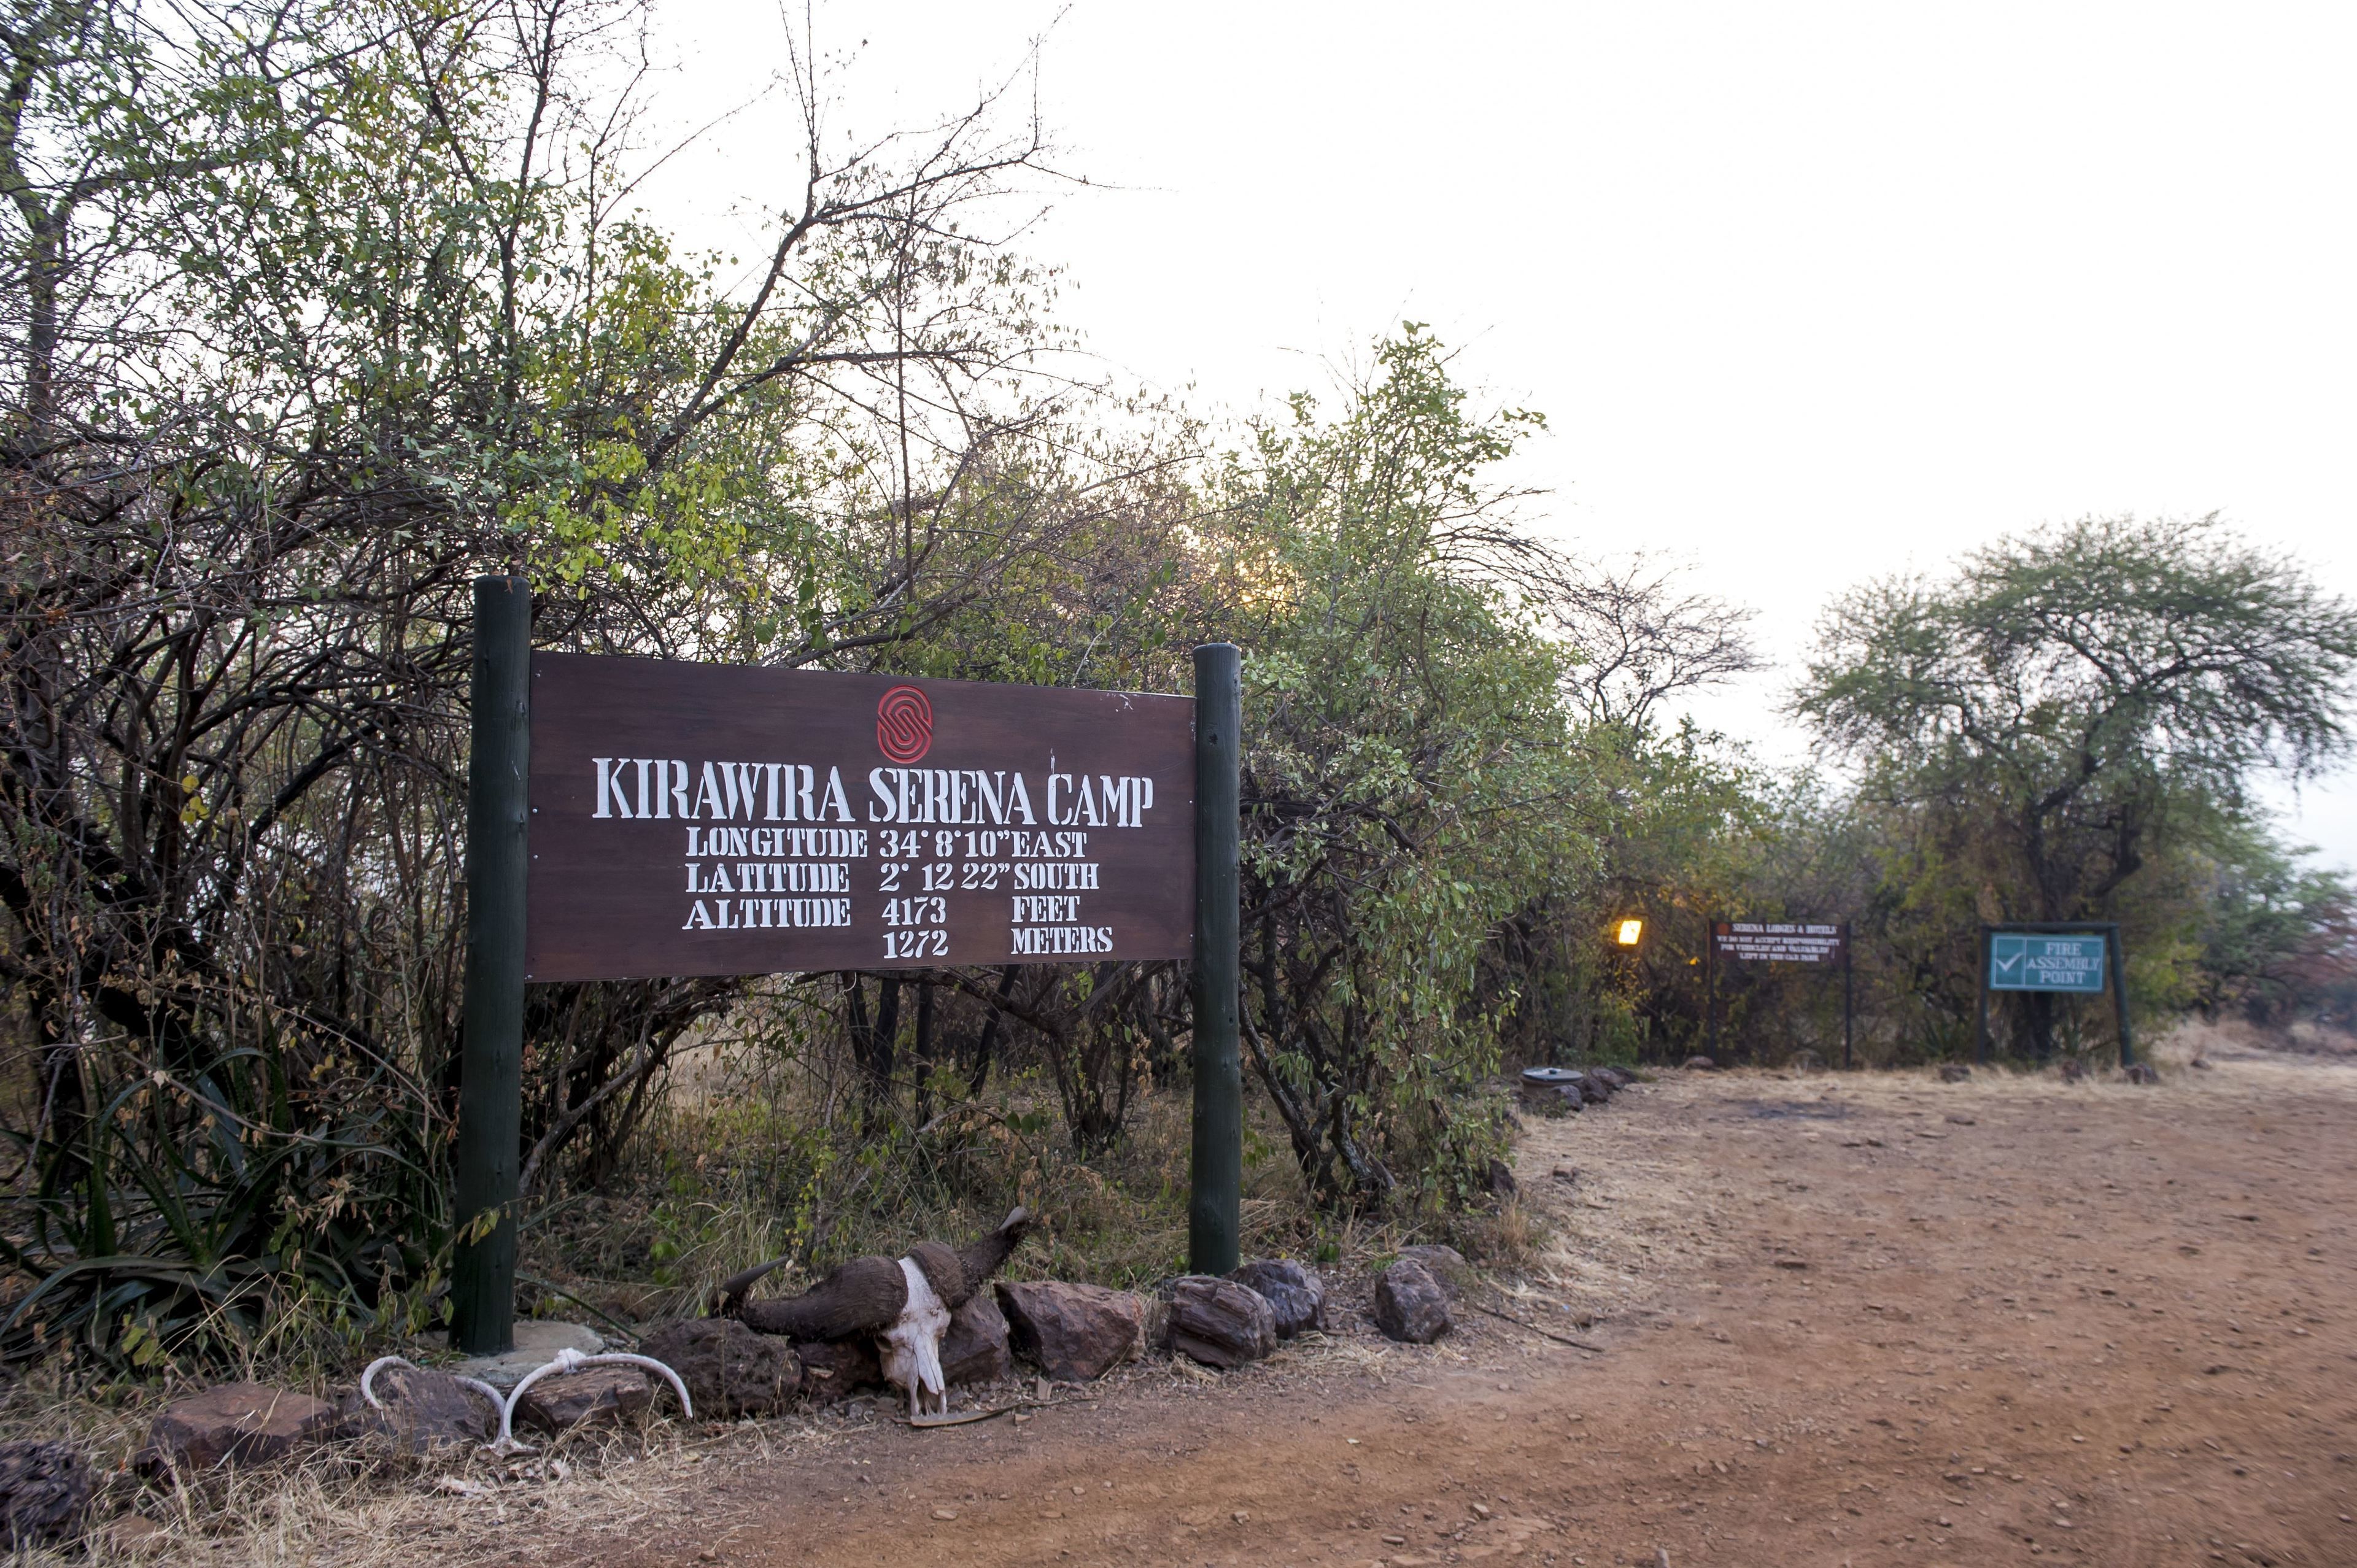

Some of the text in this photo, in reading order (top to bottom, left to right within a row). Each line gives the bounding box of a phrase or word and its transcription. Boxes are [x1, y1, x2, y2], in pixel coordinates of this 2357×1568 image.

[592, 757, 1153, 827] KIRAWIRA SERENA CAMP
[686, 827, 868, 857] LONGITUDE
[1011, 830, 1087, 858] EAST
[685, 863, 850, 892] LATITUDE
[921, 863, 954, 891] 12
[1014, 863, 1099, 890] SOUTH
[682, 895, 1080, 930] ALTITUDE 4173 FEET
[883, 927, 1113, 959] 1272 METERS
[2046, 942, 2082, 956] FIRE
[2027, 957, 2100, 971] ASSEMBLY
[2040, 970, 2086, 984] POINT
